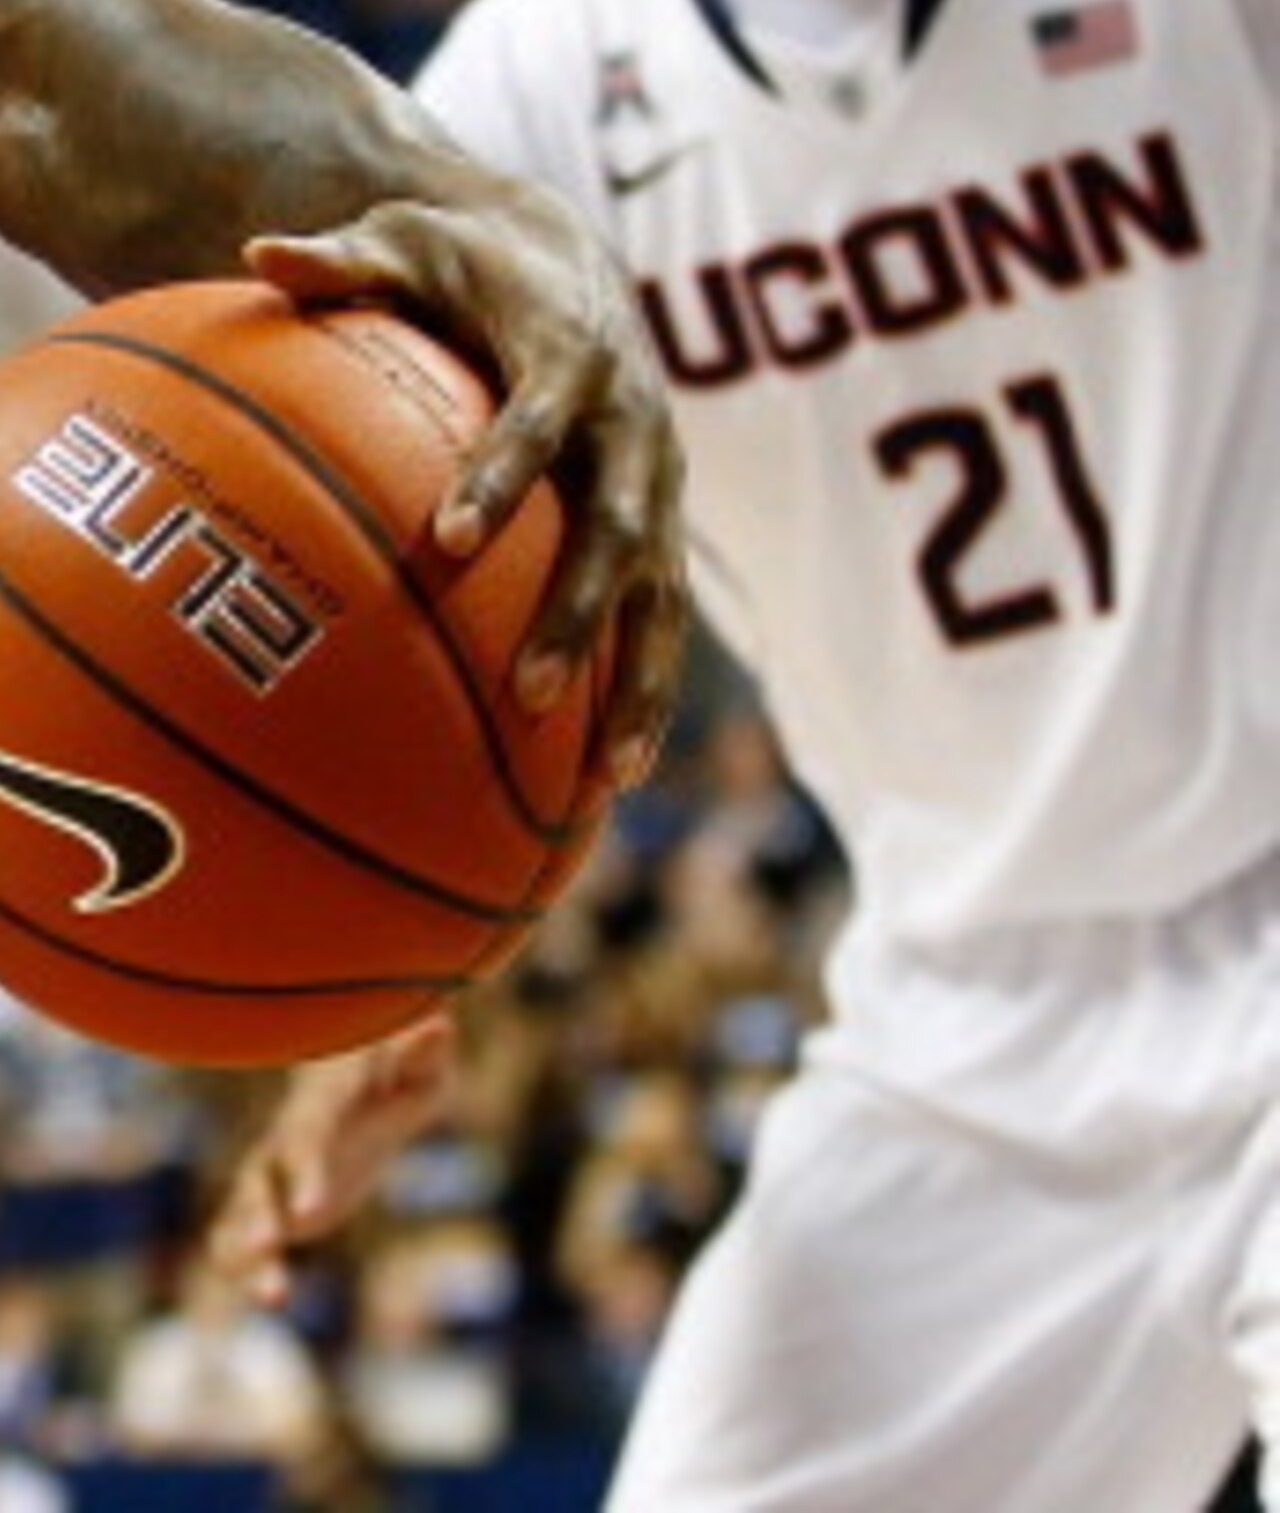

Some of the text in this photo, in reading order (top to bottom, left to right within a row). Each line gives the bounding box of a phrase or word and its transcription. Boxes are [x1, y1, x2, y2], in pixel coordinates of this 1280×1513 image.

[635, 126, 1205, 390] UCONN
[11, 412, 327, 699] ELITE
[870, 372, 1117, 651] 21
